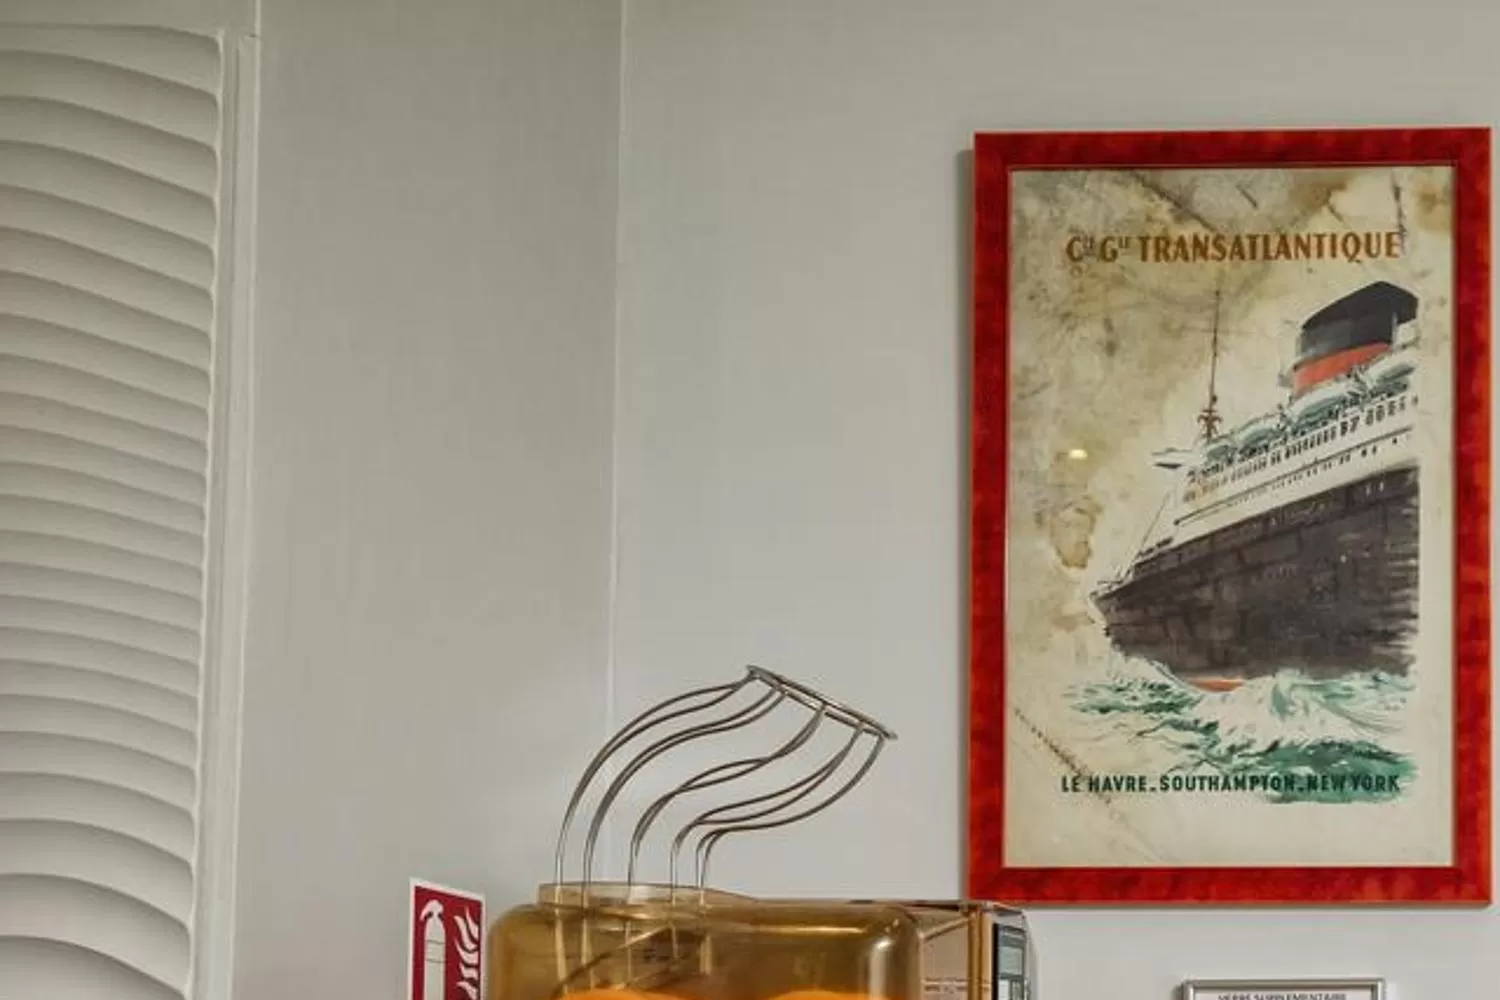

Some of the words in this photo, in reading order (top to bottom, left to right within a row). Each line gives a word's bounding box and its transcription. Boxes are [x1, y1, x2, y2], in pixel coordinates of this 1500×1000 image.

[1136, 232, 1401, 263] TRANSATLANTIQUE
[1061, 775, 1080, 792] LE
[1350, 774, 1402, 792] YORK
